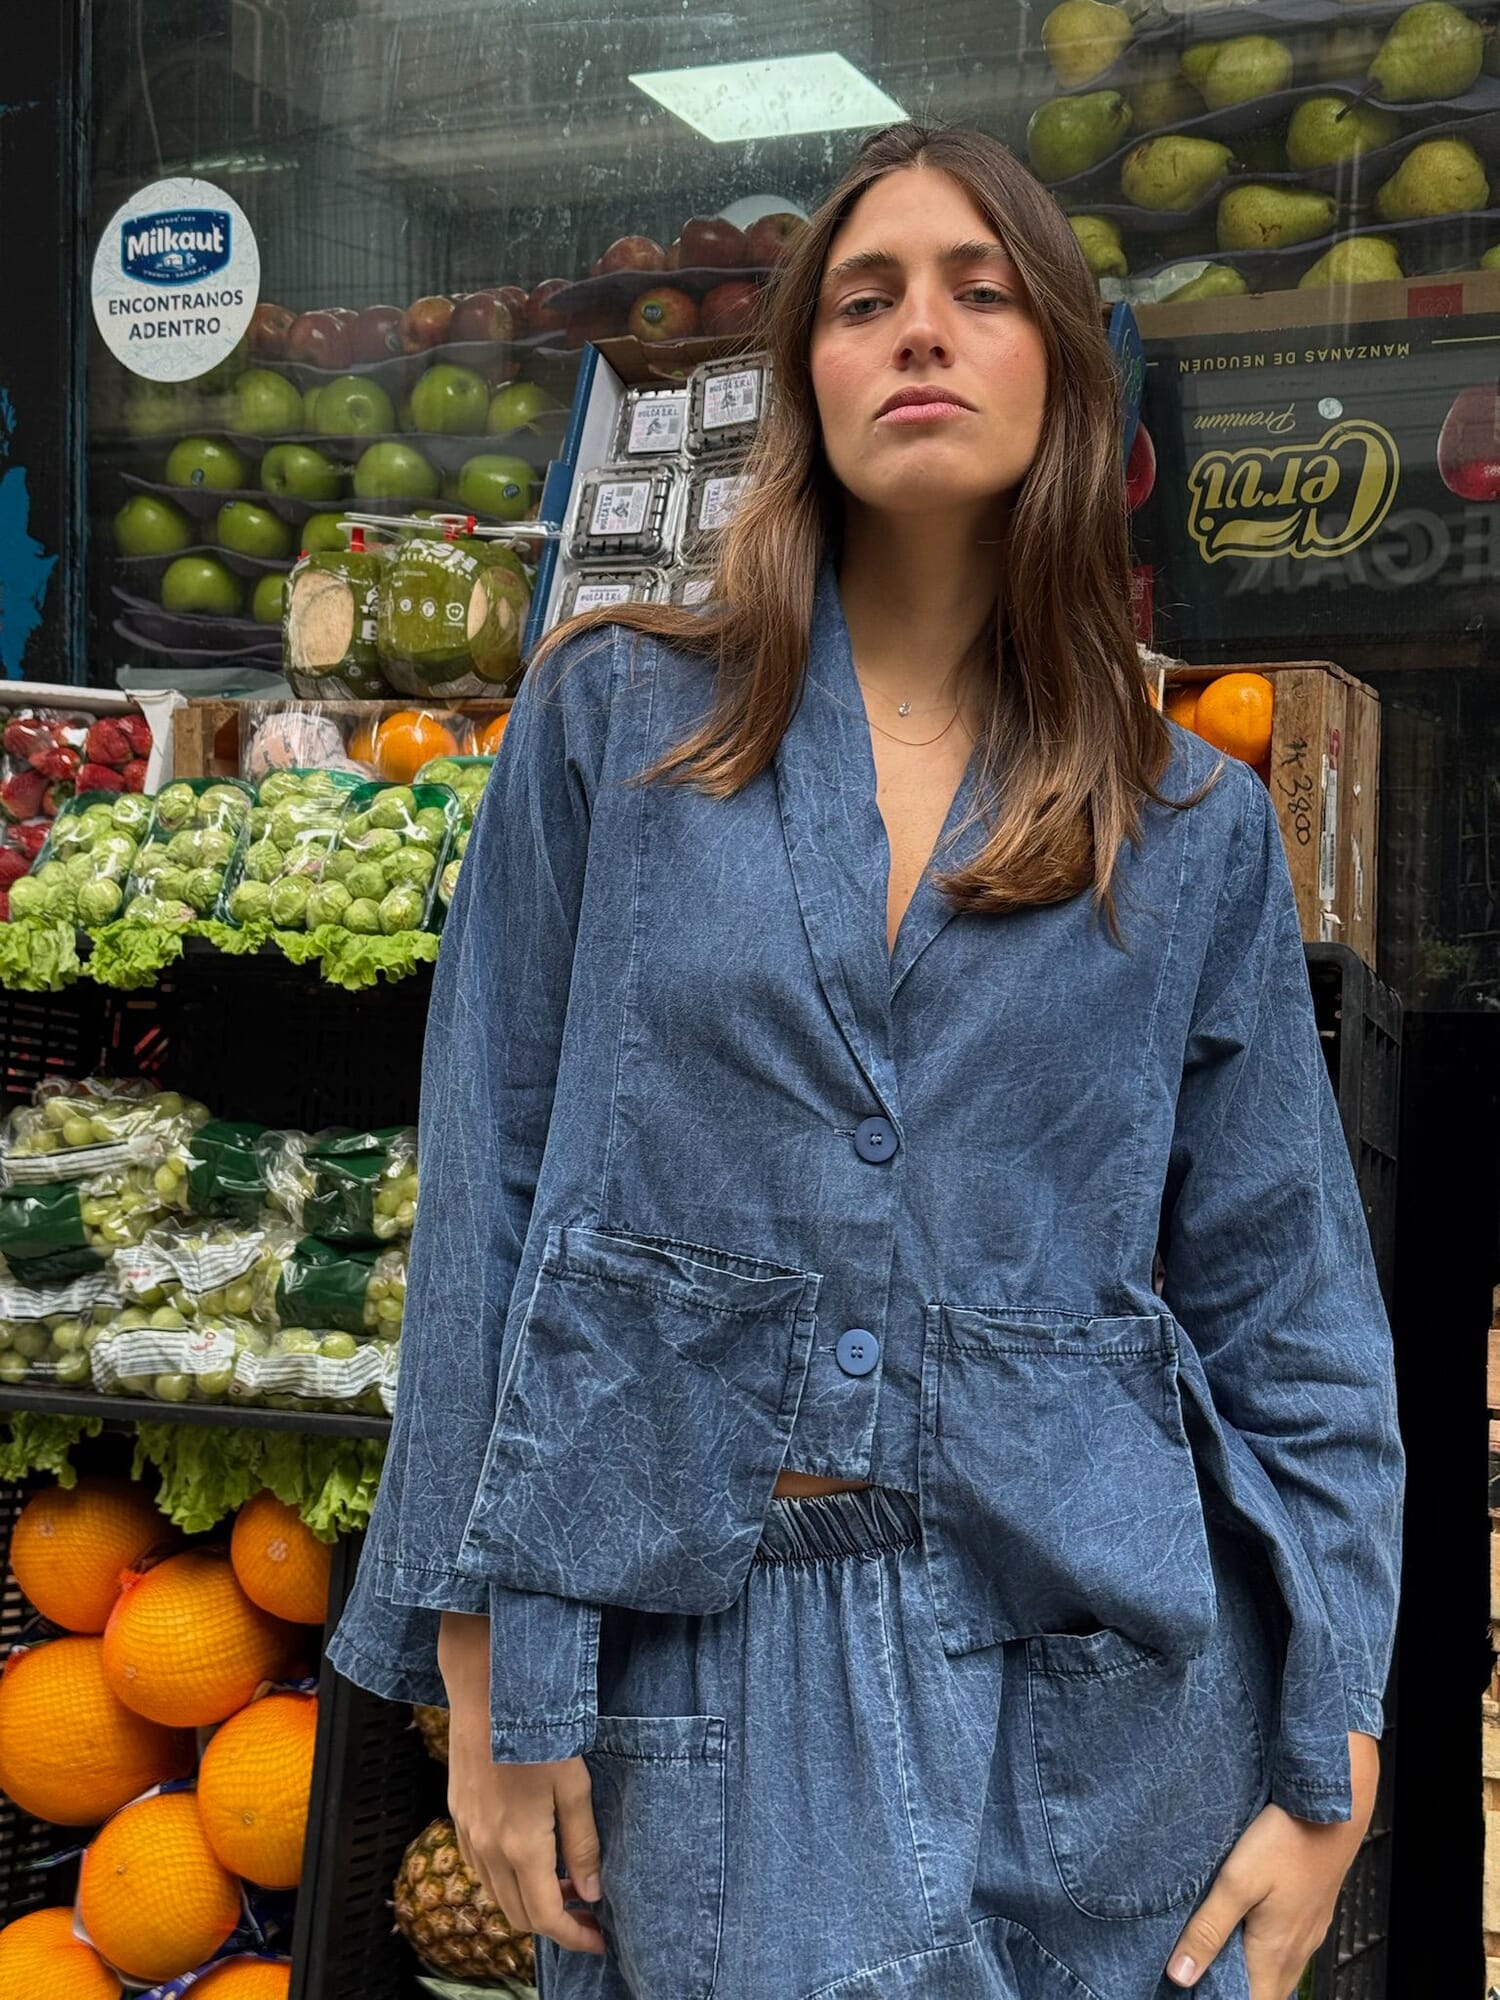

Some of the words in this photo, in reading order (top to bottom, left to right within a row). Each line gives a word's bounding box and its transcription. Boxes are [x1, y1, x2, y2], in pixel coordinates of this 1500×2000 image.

[127, 225, 224, 261] Milkaut
[109, 290, 243, 315] ENCONTRANOS
[129, 317, 221, 340] ADENTRO
[1179, 354, 1266, 375] NEUQUÉN
[1274, 352, 1296, 364] DE
[1306, 343, 1410, 363] MANZANAS
[1193, 402, 1297, 434] Premium
[1197, 429, 1391, 548] Cervi
[1277, 775, 1313, 846] 3800
